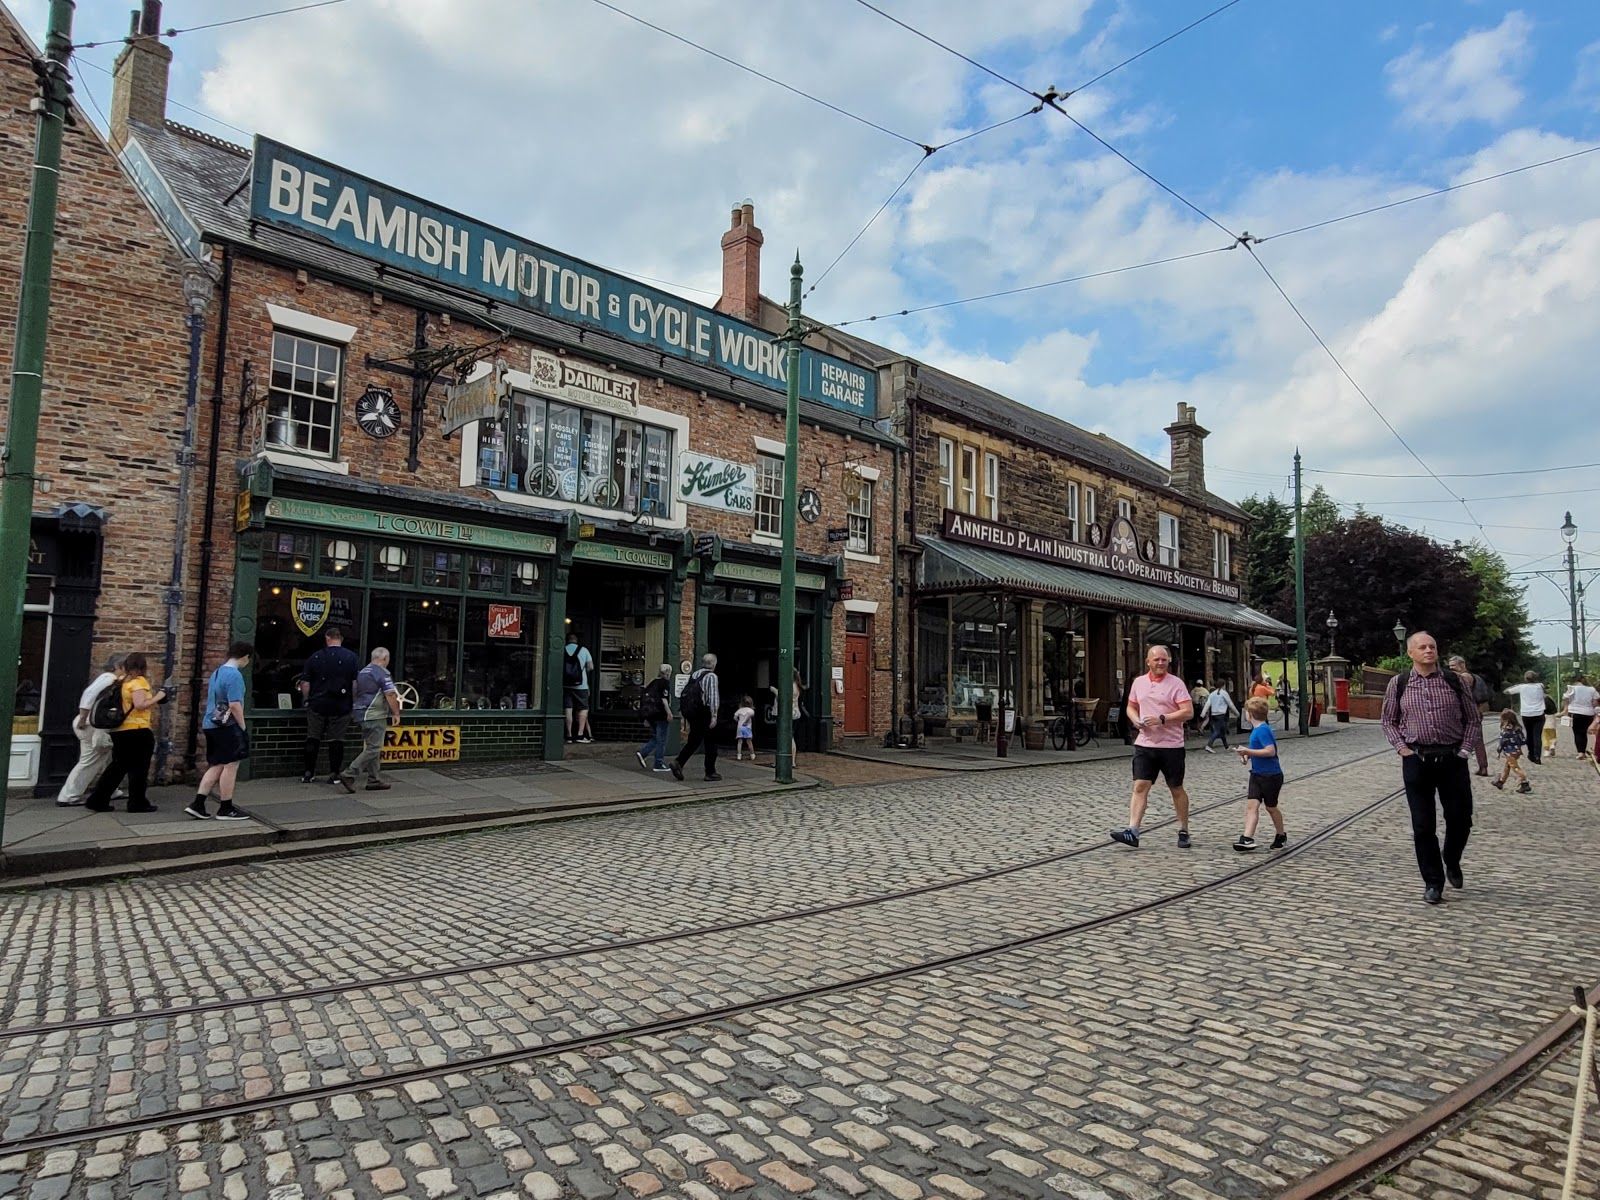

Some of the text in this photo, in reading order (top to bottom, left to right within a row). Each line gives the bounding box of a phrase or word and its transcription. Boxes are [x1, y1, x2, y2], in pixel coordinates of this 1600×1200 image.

[268, 158, 789, 383] BEAMISH MOTOR & CYCLE WORK
[564, 367, 632, 401] DAIMLER
[821, 362, 865, 391] REPAIRS
[821, 380, 865, 408] GARAGE
[550, 423, 578, 436] CROSSLEY
[555, 432, 572, 441] CARS
[681, 461, 747, 496] Humber
[391, 517, 454, 539] COWIE
[625, 551, 657, 566] COWIE
[950, 514, 1015, 547] ANNFIELD
[1017, 530, 1052, 555] PLAIN
[1053, 539, 1110, 570] INDUSTRIAL
[1111, 554, 1173, 584] CO-OPERATIVE
[1173, 570, 1205, 591] SOCIETY
[1212, 579, 1239, 599] BEAMISH
[297, 599, 325, 612] RALEIGH
[299, 611, 321, 623] Cycles
[489, 607, 519, 635] Ariel
[383, 728, 456, 747] RATT'S
[380, 747, 457, 761] RFECTION SPIRIT
